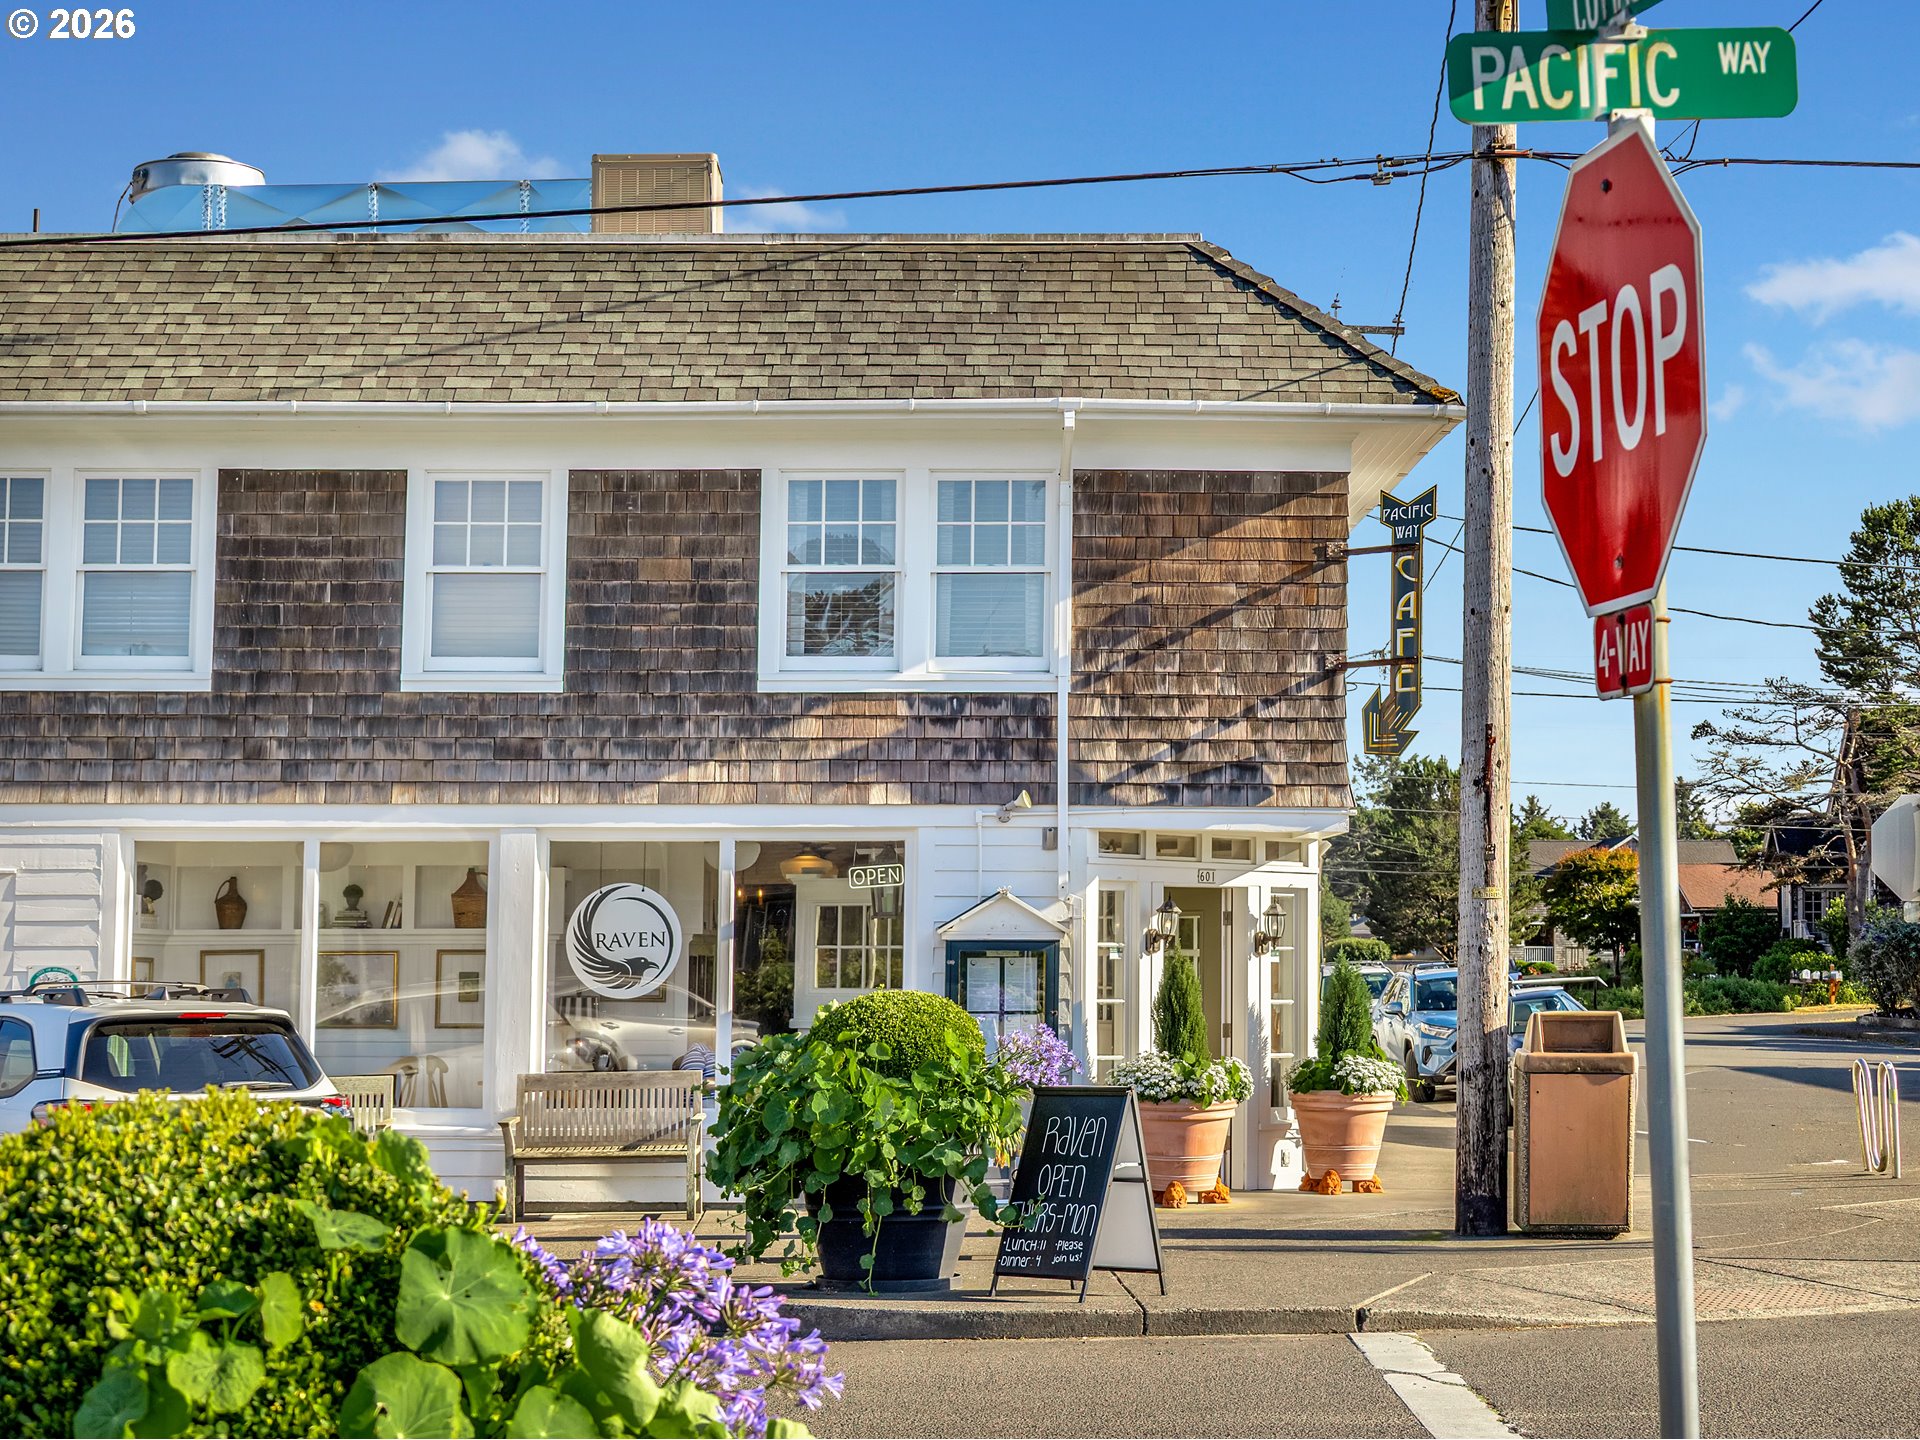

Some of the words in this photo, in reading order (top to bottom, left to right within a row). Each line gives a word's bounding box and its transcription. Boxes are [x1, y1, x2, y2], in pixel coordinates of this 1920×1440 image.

[1470, 41, 1681, 111] PACIFIC
[1717, 40, 1772, 75] WAY
[1550, 263, 1688, 478] STOP
[1382, 503, 1433, 522] PACIFIC
[1395, 523, 1420, 540] WAY
[1598, 618, 1649, 679] 4-WAY
[852, 867, 901, 886] OPEN
[1199, 871, 1215, 882] 601
[595, 930, 667, 952] RAVEN
[1037, 1163, 1087, 1199] OPEN
[1051, 1253, 1067, 1265] join
[1069, 1251, 1083, 1262] us!
